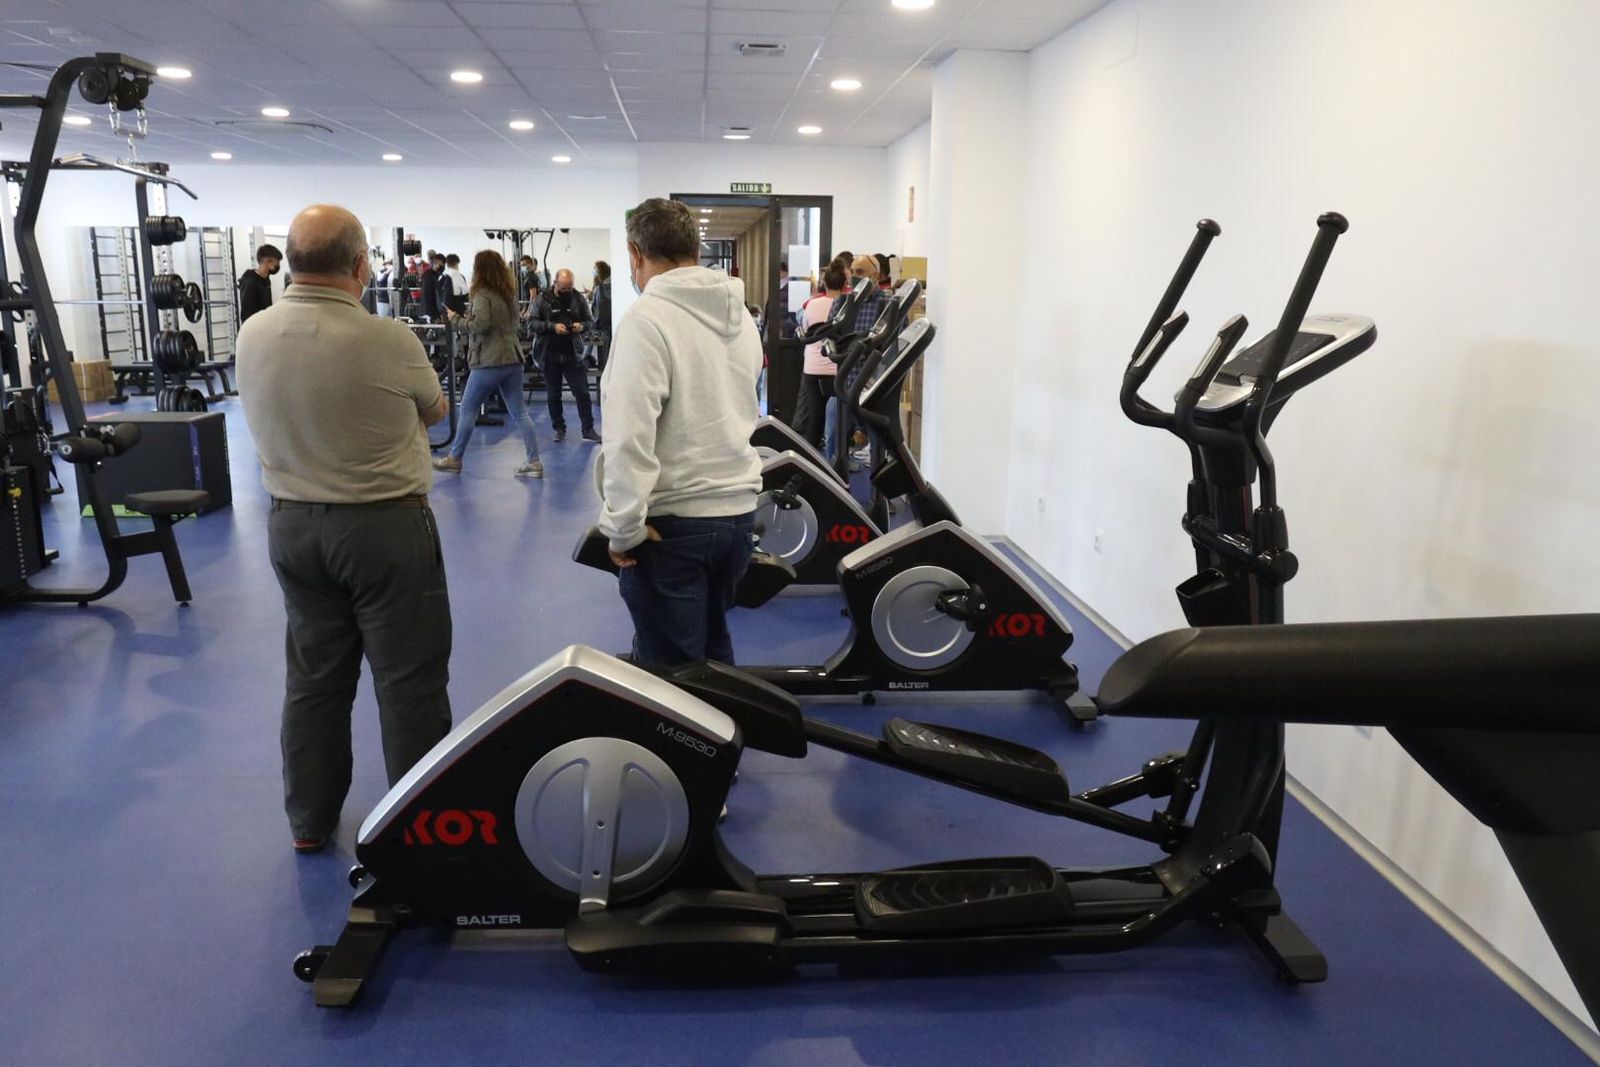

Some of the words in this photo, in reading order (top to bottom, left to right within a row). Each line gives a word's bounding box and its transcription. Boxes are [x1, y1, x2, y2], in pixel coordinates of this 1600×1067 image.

[732, 183, 759, 193] SALIDA
[404, 809, 498, 845] KOR
[456, 914, 521, 926] SALTER
